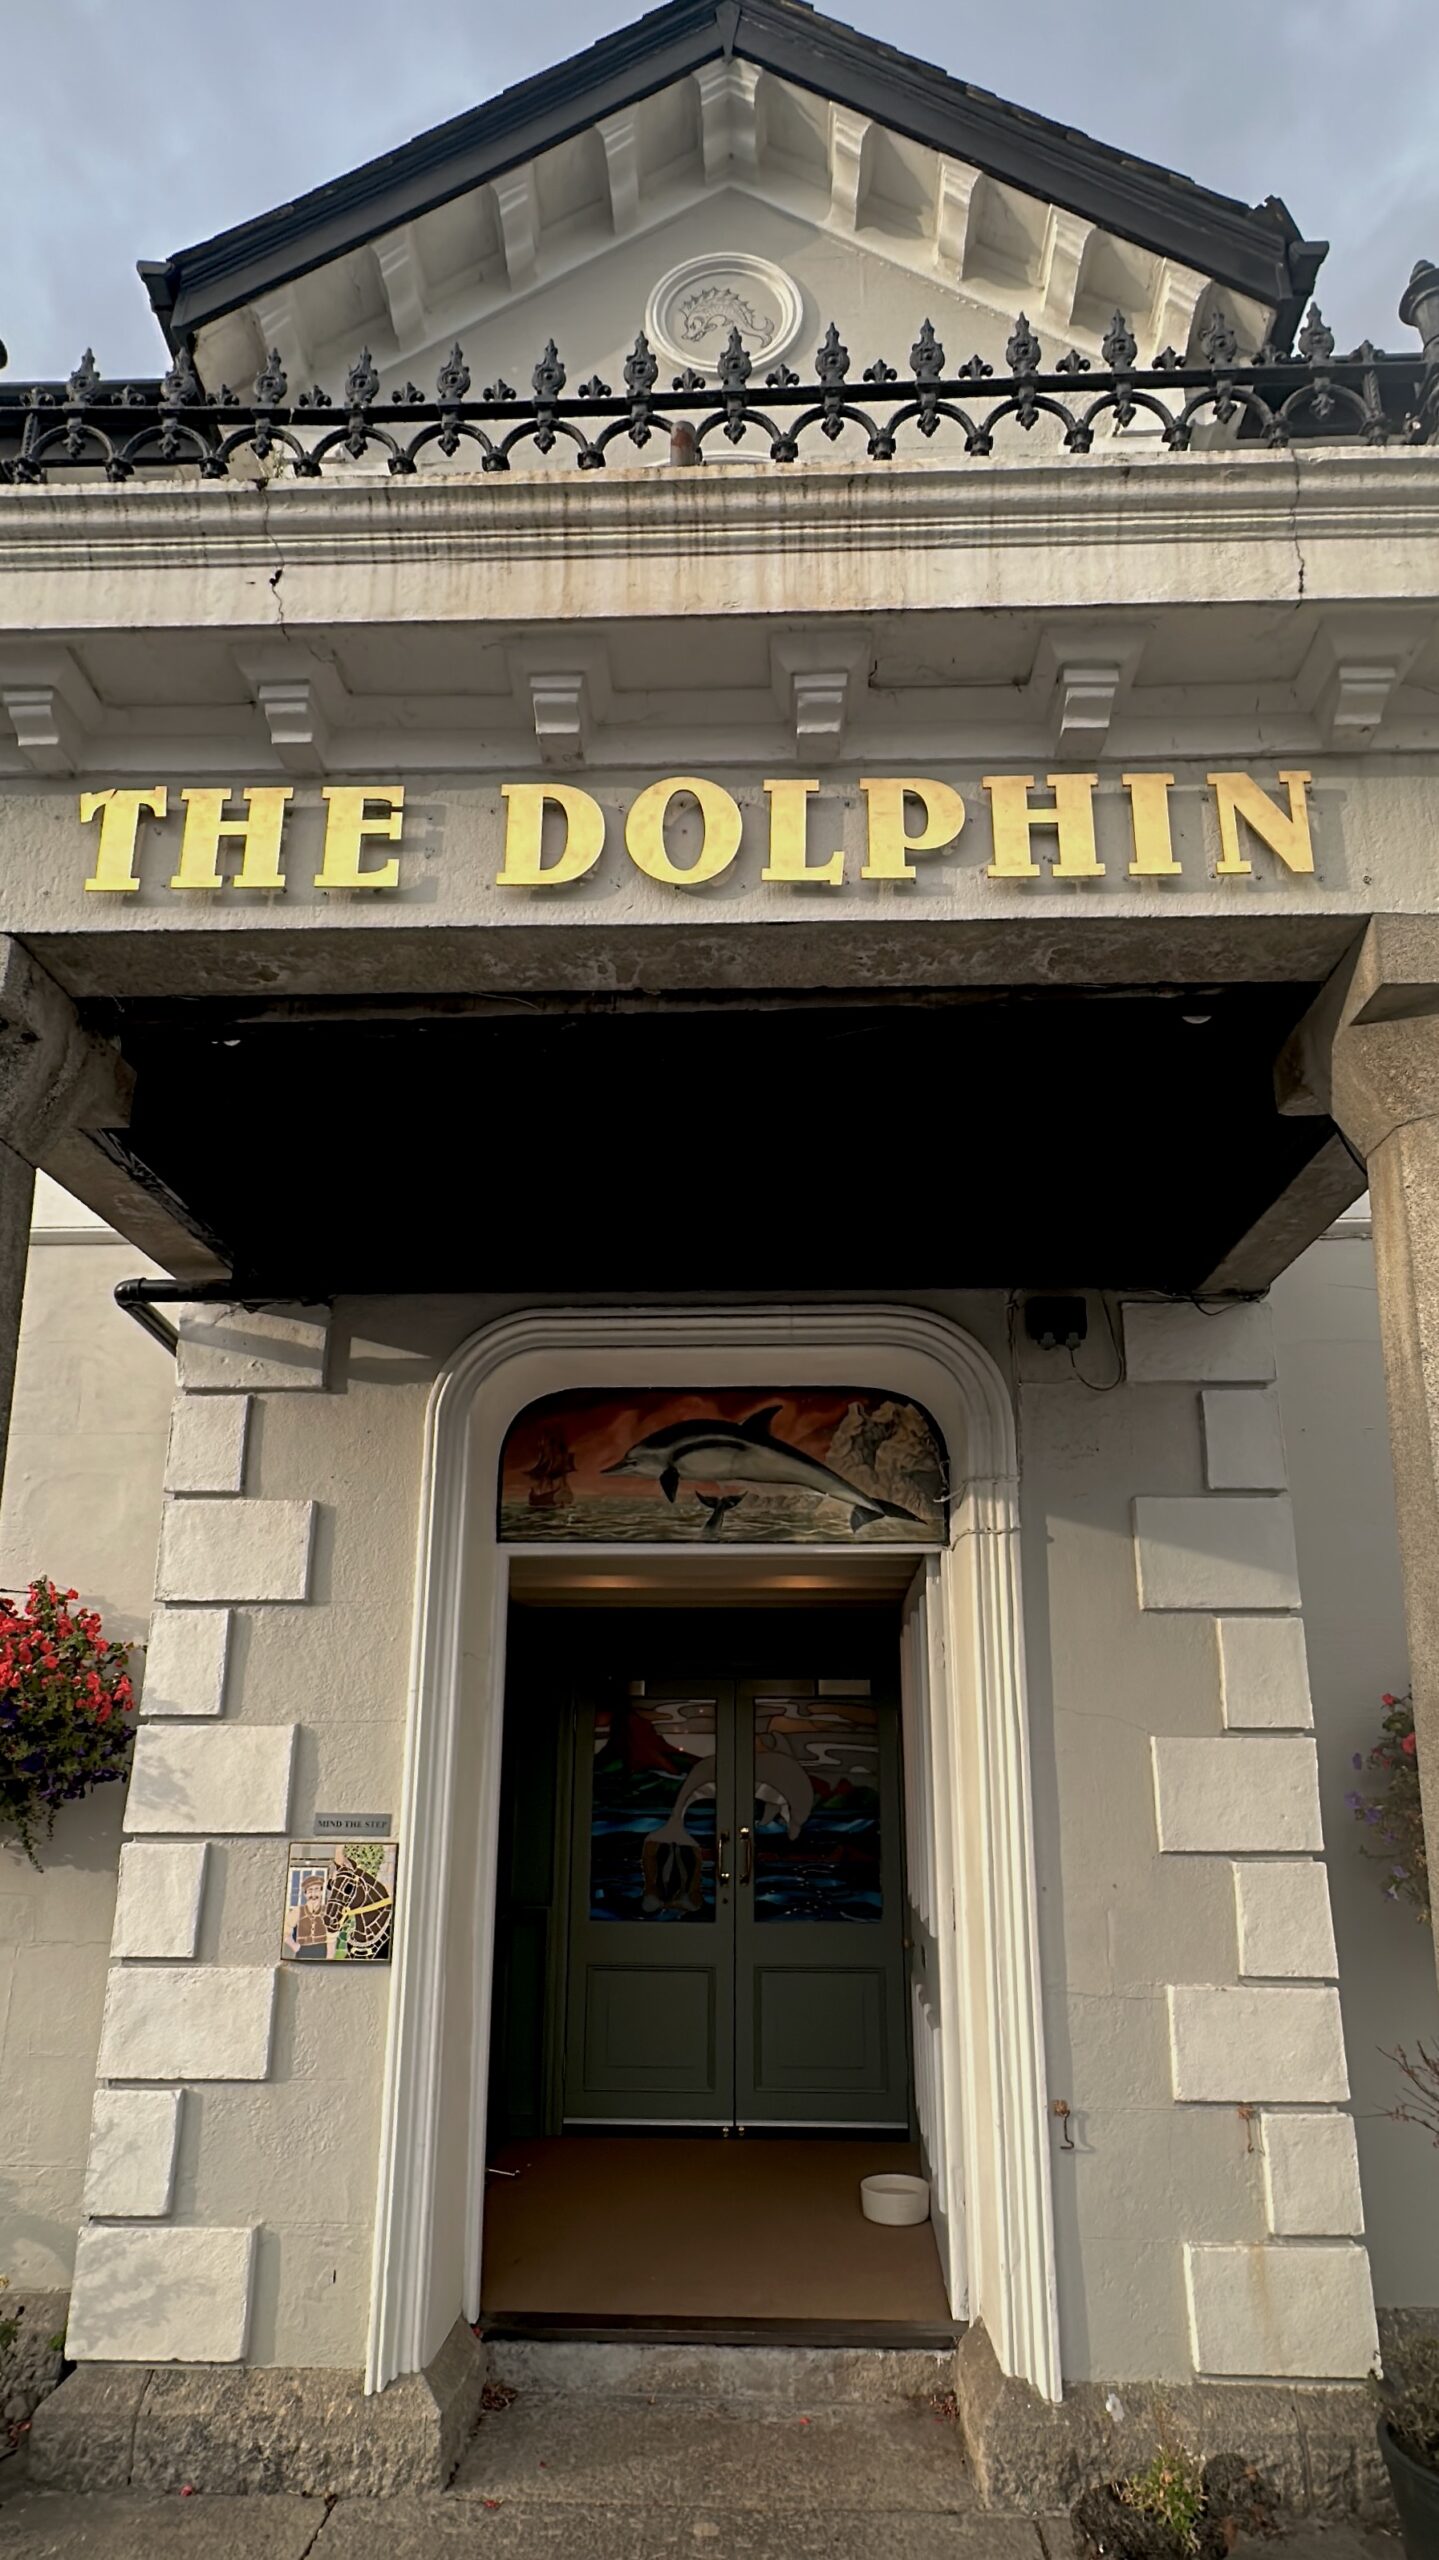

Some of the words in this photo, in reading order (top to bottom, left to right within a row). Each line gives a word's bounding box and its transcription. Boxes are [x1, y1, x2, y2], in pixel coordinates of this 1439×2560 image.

[80, 786, 404, 892] THE
[496, 770, 1315, 887] DOLPHIN
[318, 1820, 342, 1828] MIND
[344, 1820, 361, 1828] THE
[365, 1820, 387, 1828] STEP
